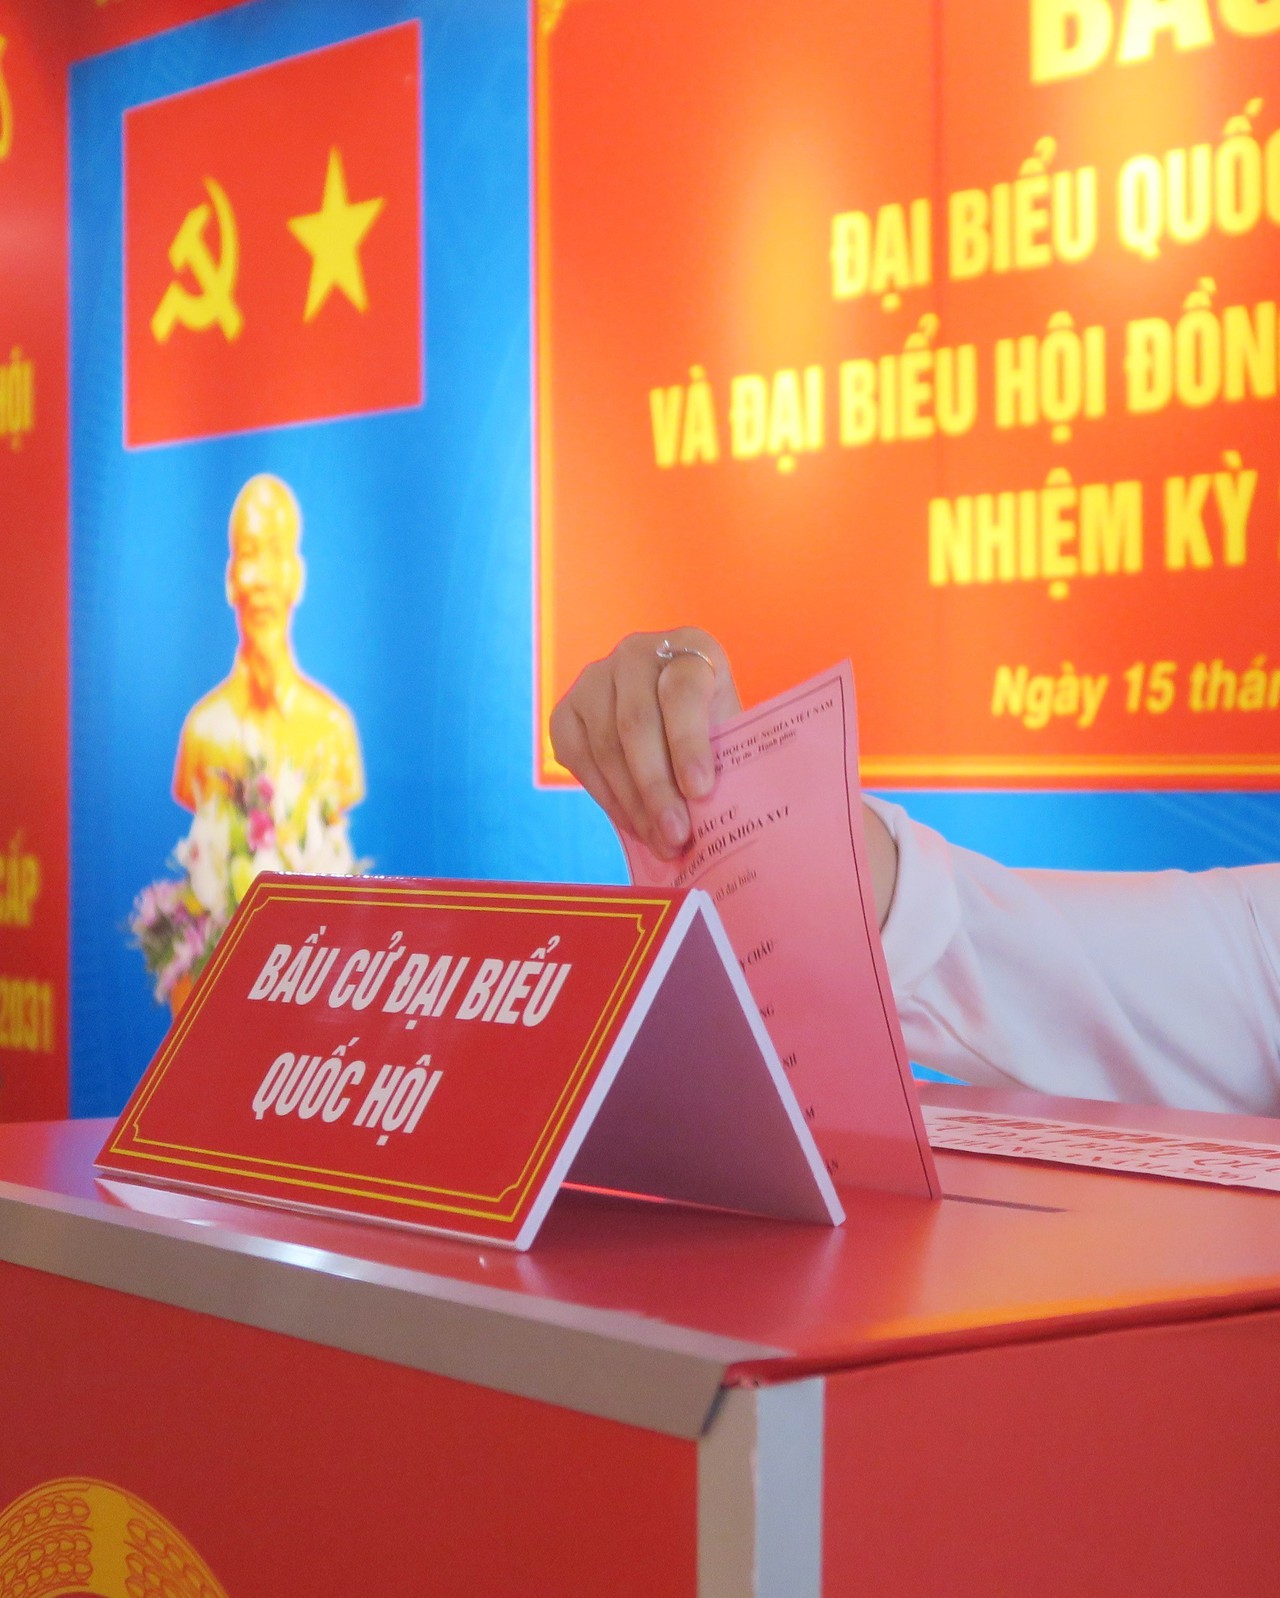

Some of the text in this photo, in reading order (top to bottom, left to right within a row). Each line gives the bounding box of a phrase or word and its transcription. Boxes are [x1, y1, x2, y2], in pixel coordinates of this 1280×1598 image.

[830, 198, 930, 311] ĐẠI
[949, 137, 1098, 281] BIỂU
[649, 364, 719, 469] VÀ
[729, 363, 824, 474] ĐẠI
[839, 313, 977, 448] BIỂU
[995, 310, 1105, 443] HỘI
[928, 467, 1143, 600] NHIỆM
[1164, 450, 1258, 570] KỲ
[991, 661, 1108, 729] Ngày
[1123, 661, 1177, 714] 15
[247, 925, 572, 1029] BẦU CỬ ĐẠI BIỂU
[251, 1037, 444, 1146] QUỐC HỘI
